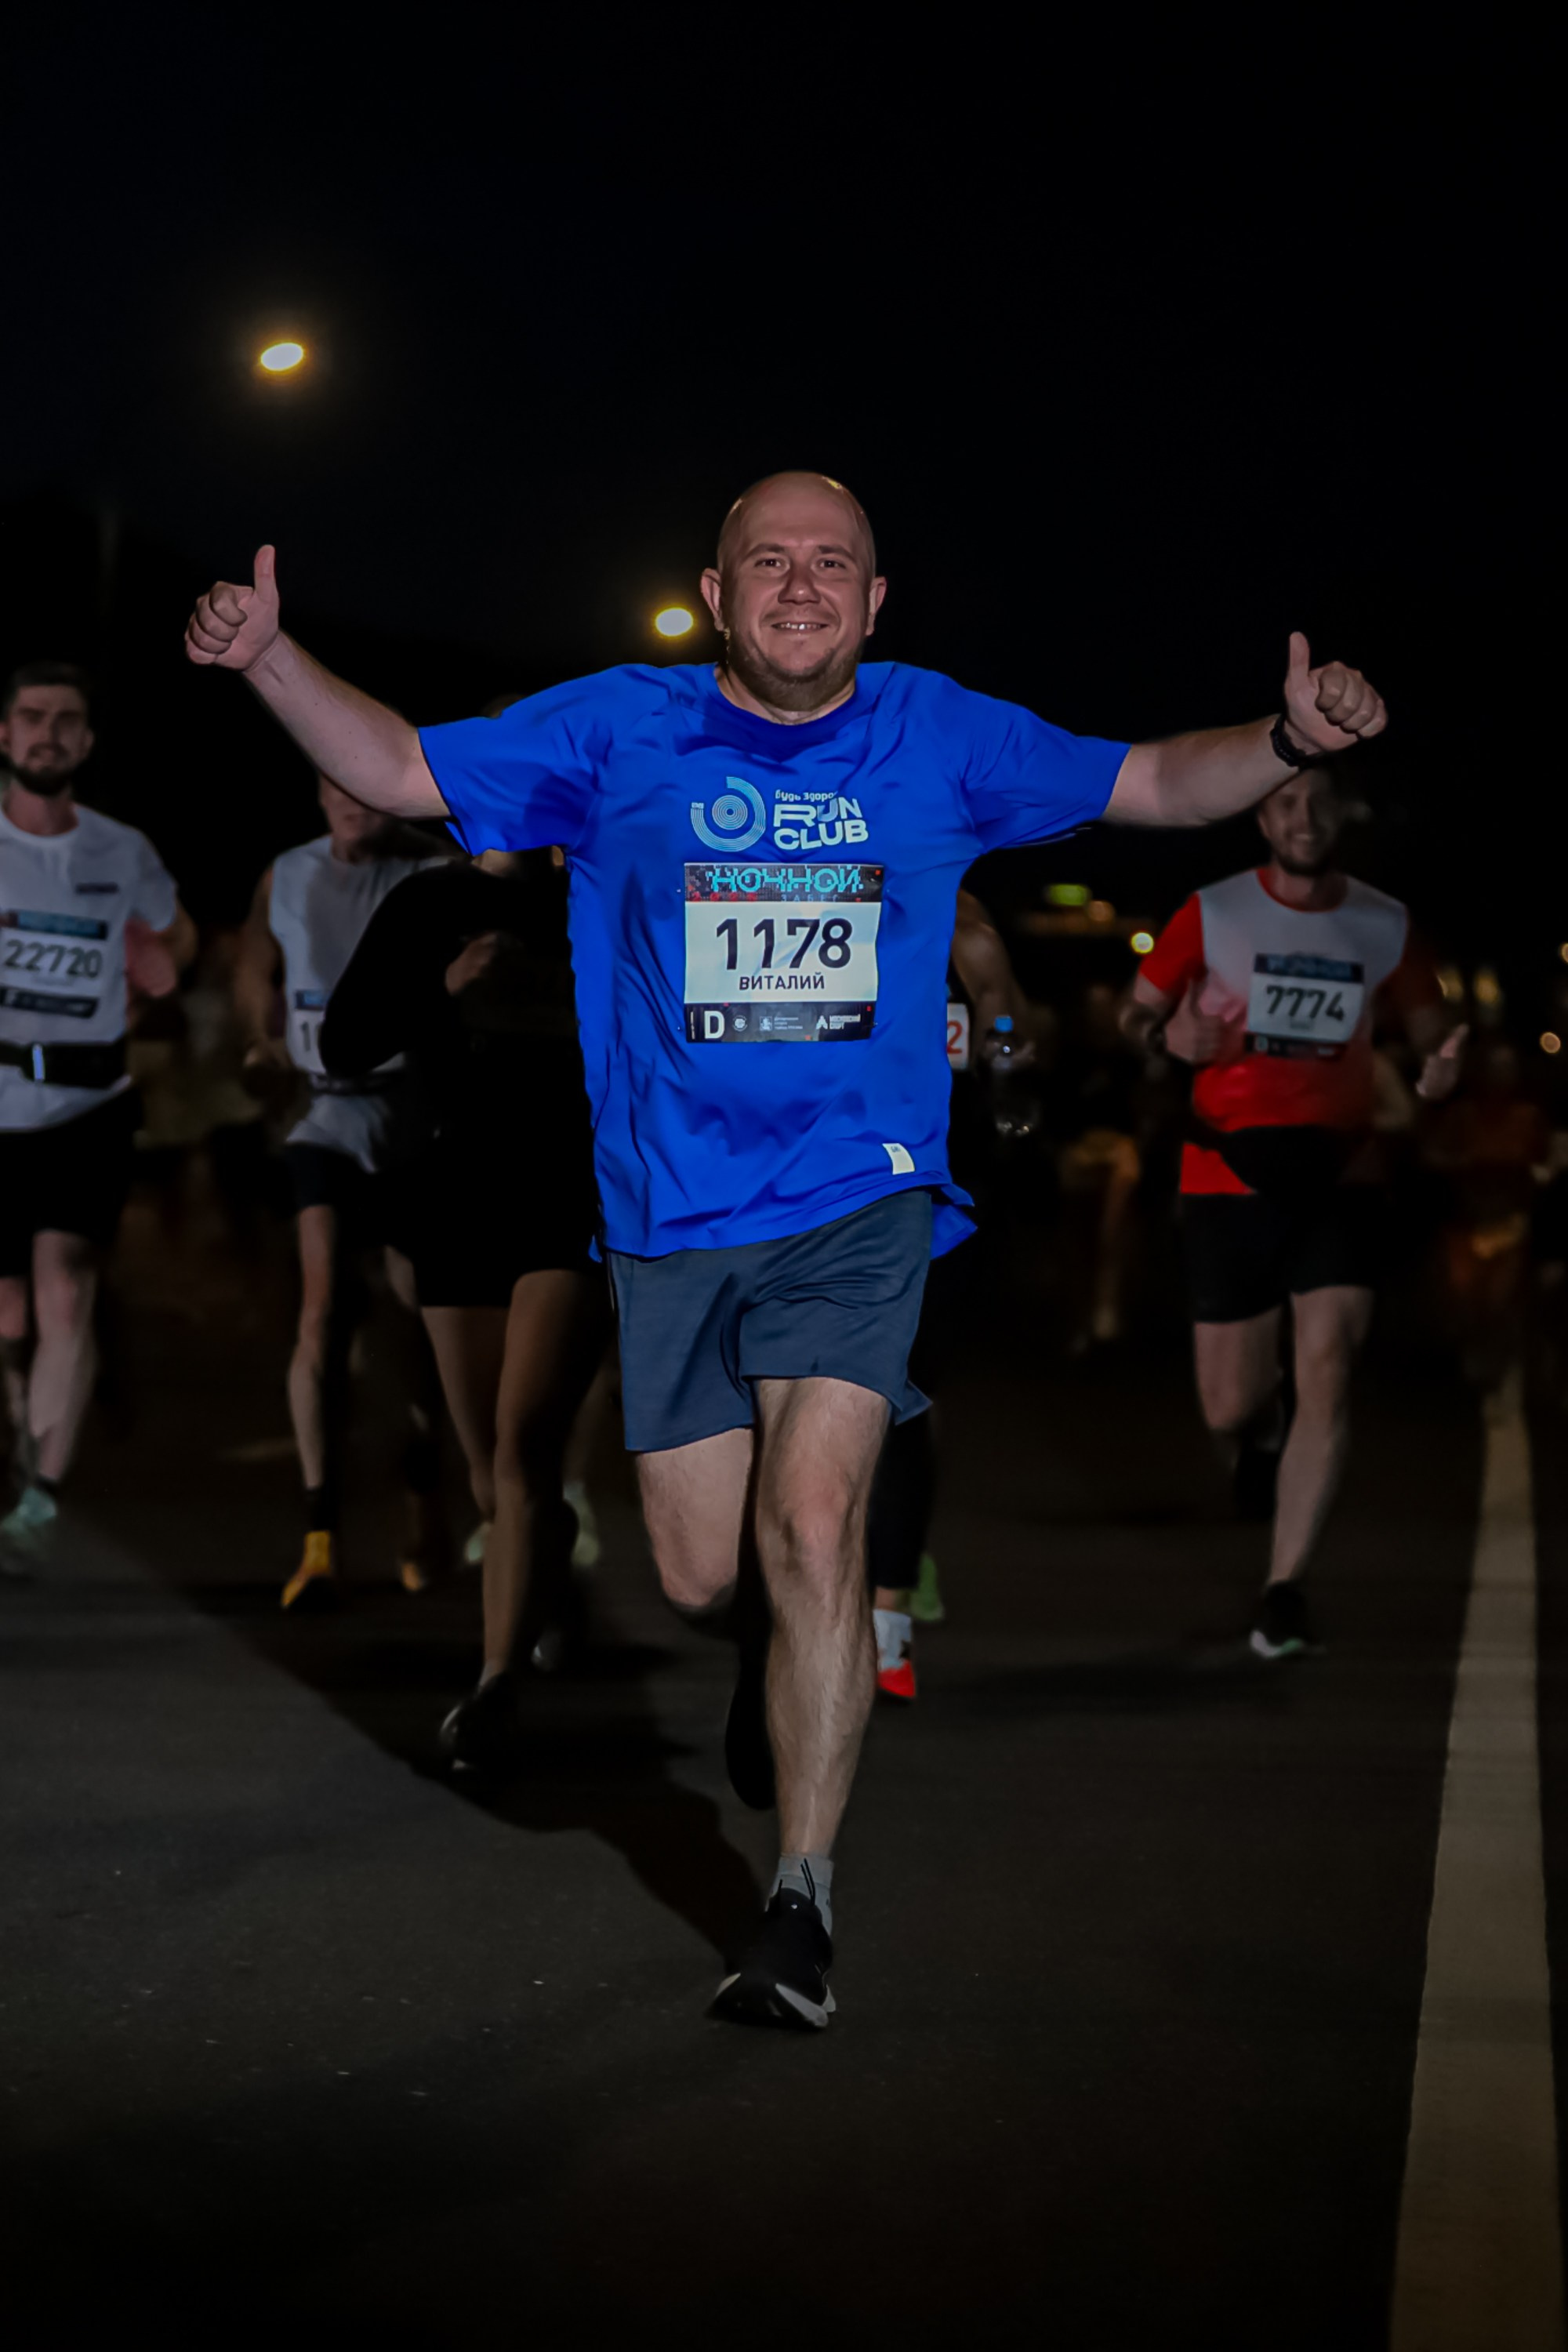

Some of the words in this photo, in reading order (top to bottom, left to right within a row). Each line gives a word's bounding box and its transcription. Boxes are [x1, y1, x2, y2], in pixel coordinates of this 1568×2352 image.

[803, 790, 838, 802] здоро
[773, 797, 862, 827] RUN
[774, 819, 869, 851] CLUB
[709, 866, 863, 893] НОЧНОЙ
[5, 939, 102, 978] 22720
[716, 918, 853, 970] 1178
[739, 972, 825, 990] ВИТАЛИЙ
[1266, 984, 1344, 1021] 7774
[704, 1010, 725, 1039] D
[946, 1020, 963, 1054] 2
